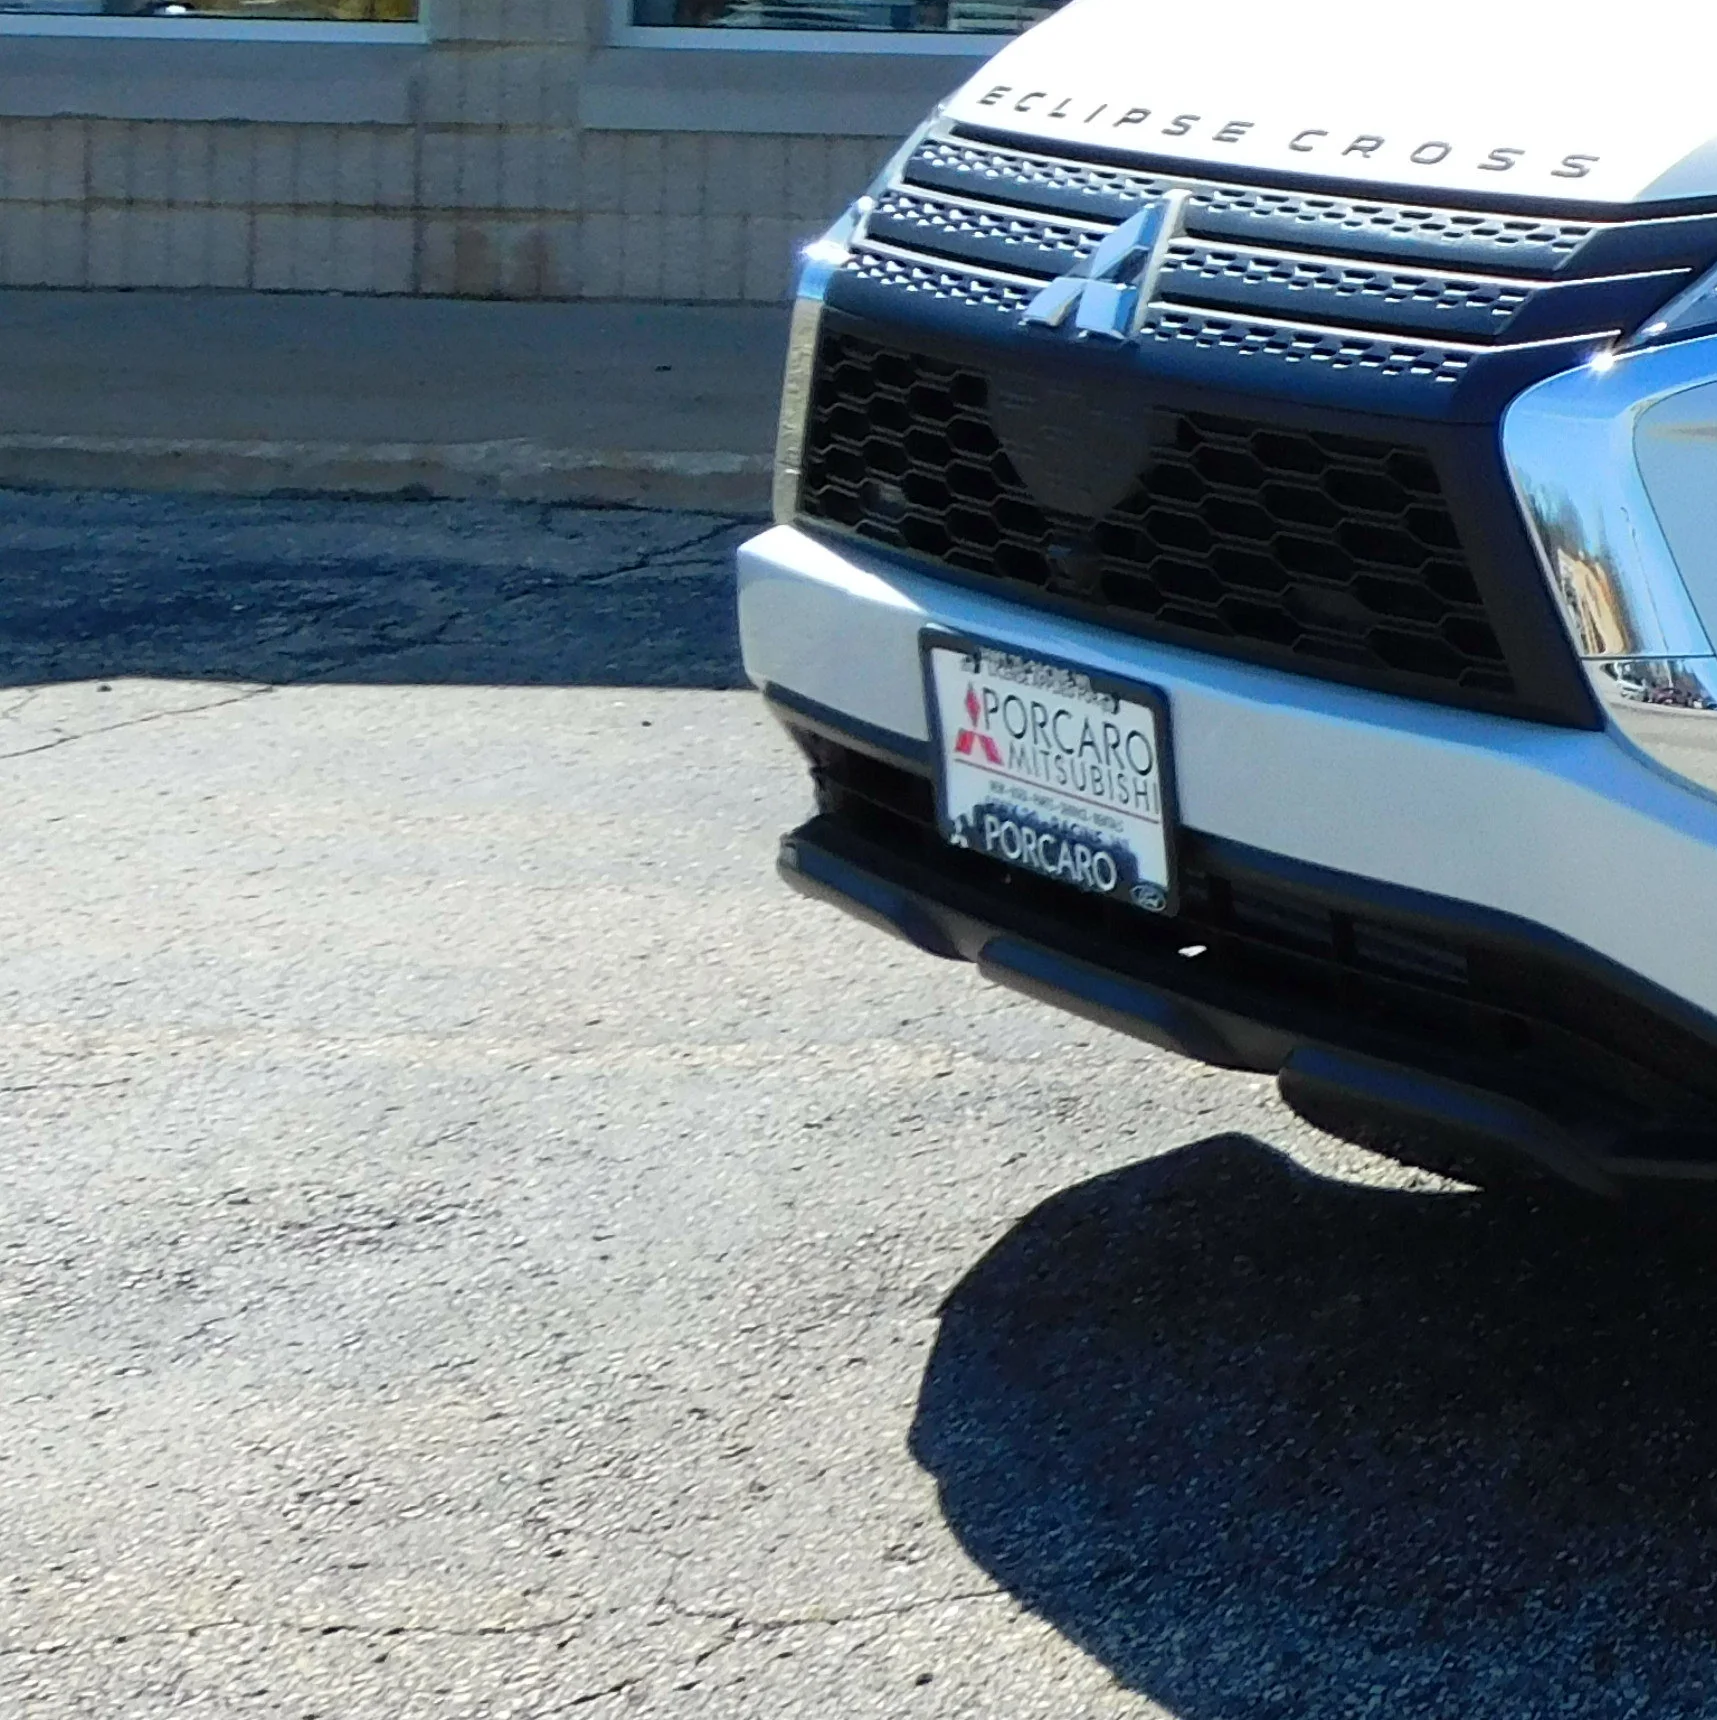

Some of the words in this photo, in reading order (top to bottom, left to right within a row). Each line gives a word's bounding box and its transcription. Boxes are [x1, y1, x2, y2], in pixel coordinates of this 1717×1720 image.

[977, 85, 1256, 143] ECLIPSE
[1287, 128, 1601, 179] CROSS
[982, 686, 1153, 776] PORCARO
[1007, 741, 1160, 815] MITSUBISHI
[984, 814, 1117, 891] PORCARO
